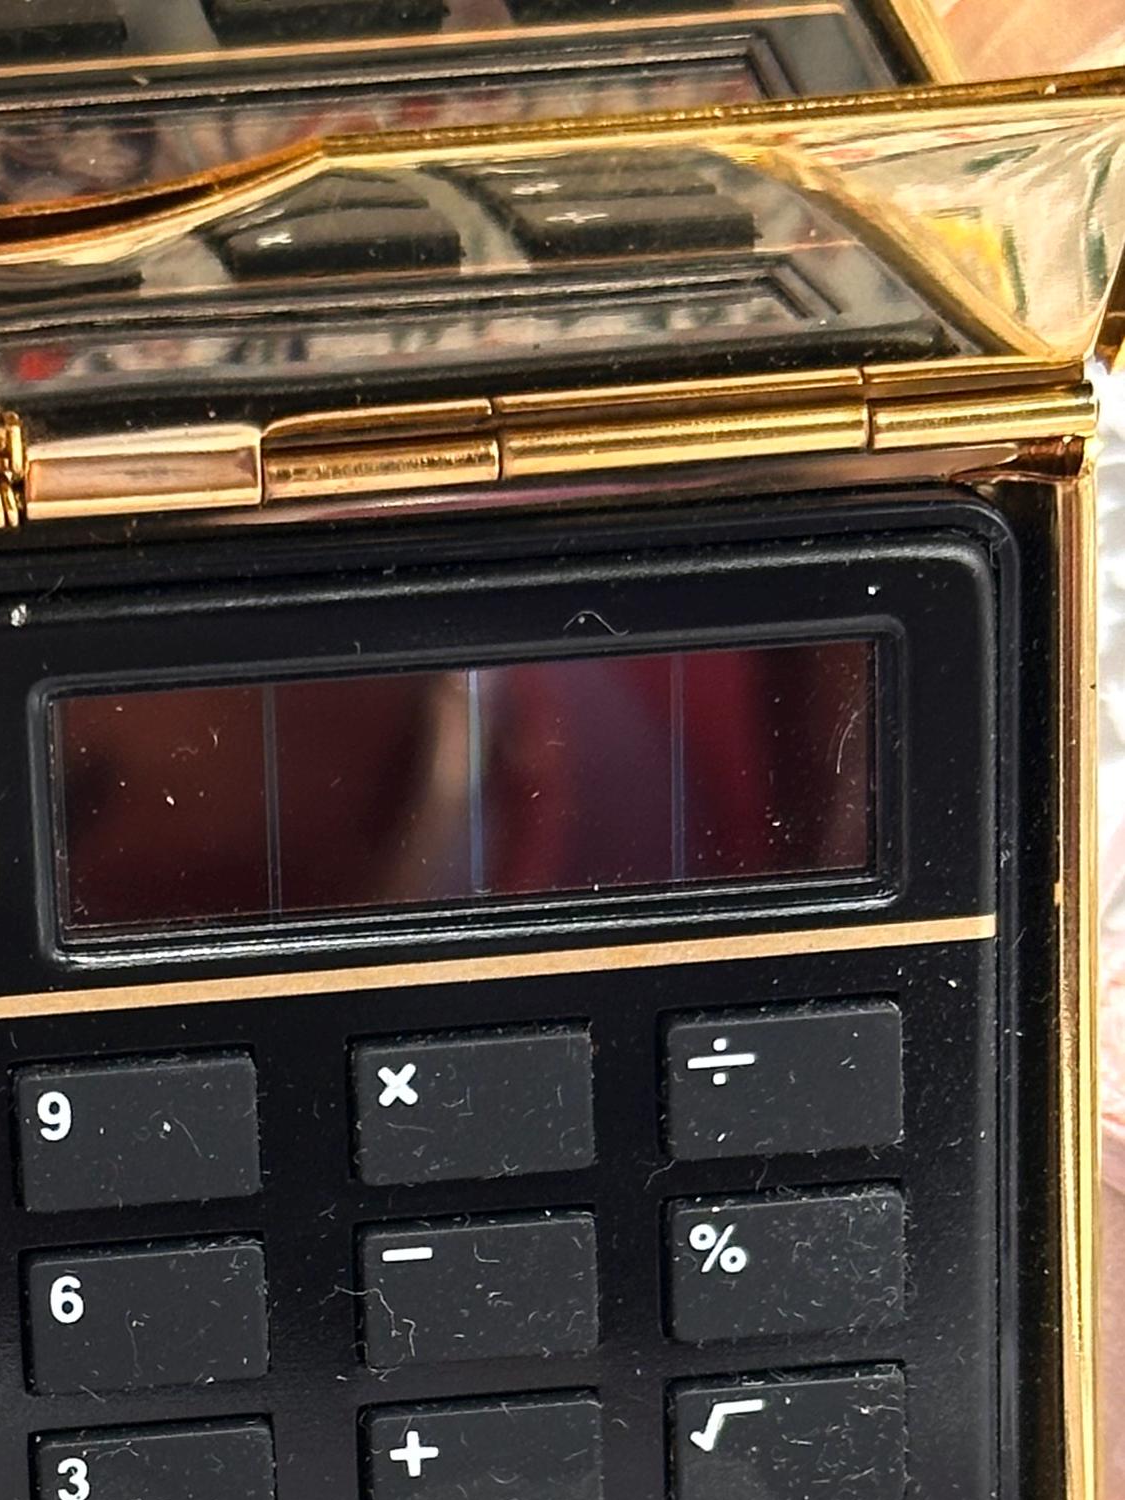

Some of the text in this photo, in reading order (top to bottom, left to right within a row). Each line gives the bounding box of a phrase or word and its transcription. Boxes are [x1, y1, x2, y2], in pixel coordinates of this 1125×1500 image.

[37, 1091, 72, 1141] 9
[689, 1223, 748, 1273] %
[50, 1275, 84, 1324] 6
